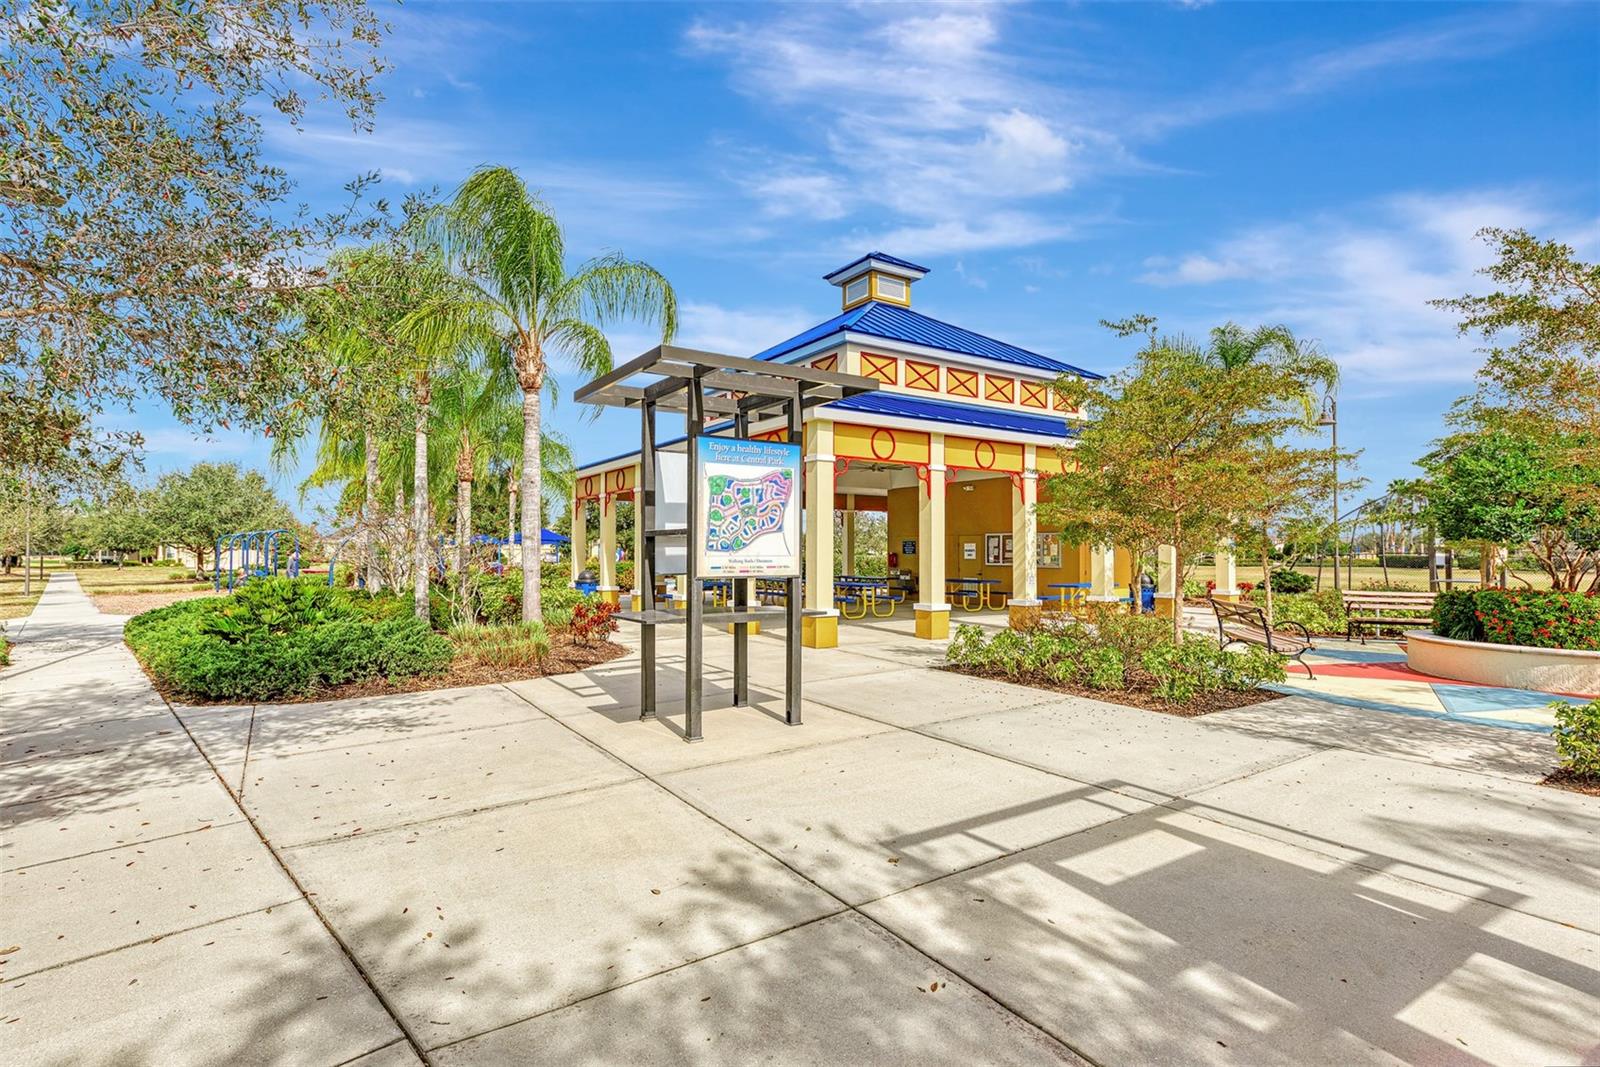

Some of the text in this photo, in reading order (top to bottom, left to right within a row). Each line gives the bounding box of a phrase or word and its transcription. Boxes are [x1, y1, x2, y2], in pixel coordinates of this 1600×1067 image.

[708, 442, 730, 453] Enjoy
[737, 443, 762, 454] healthy
[763, 446, 790, 456] lifestyle
[741, 455, 766, 464] Central
[767, 456, 785, 465] Park
